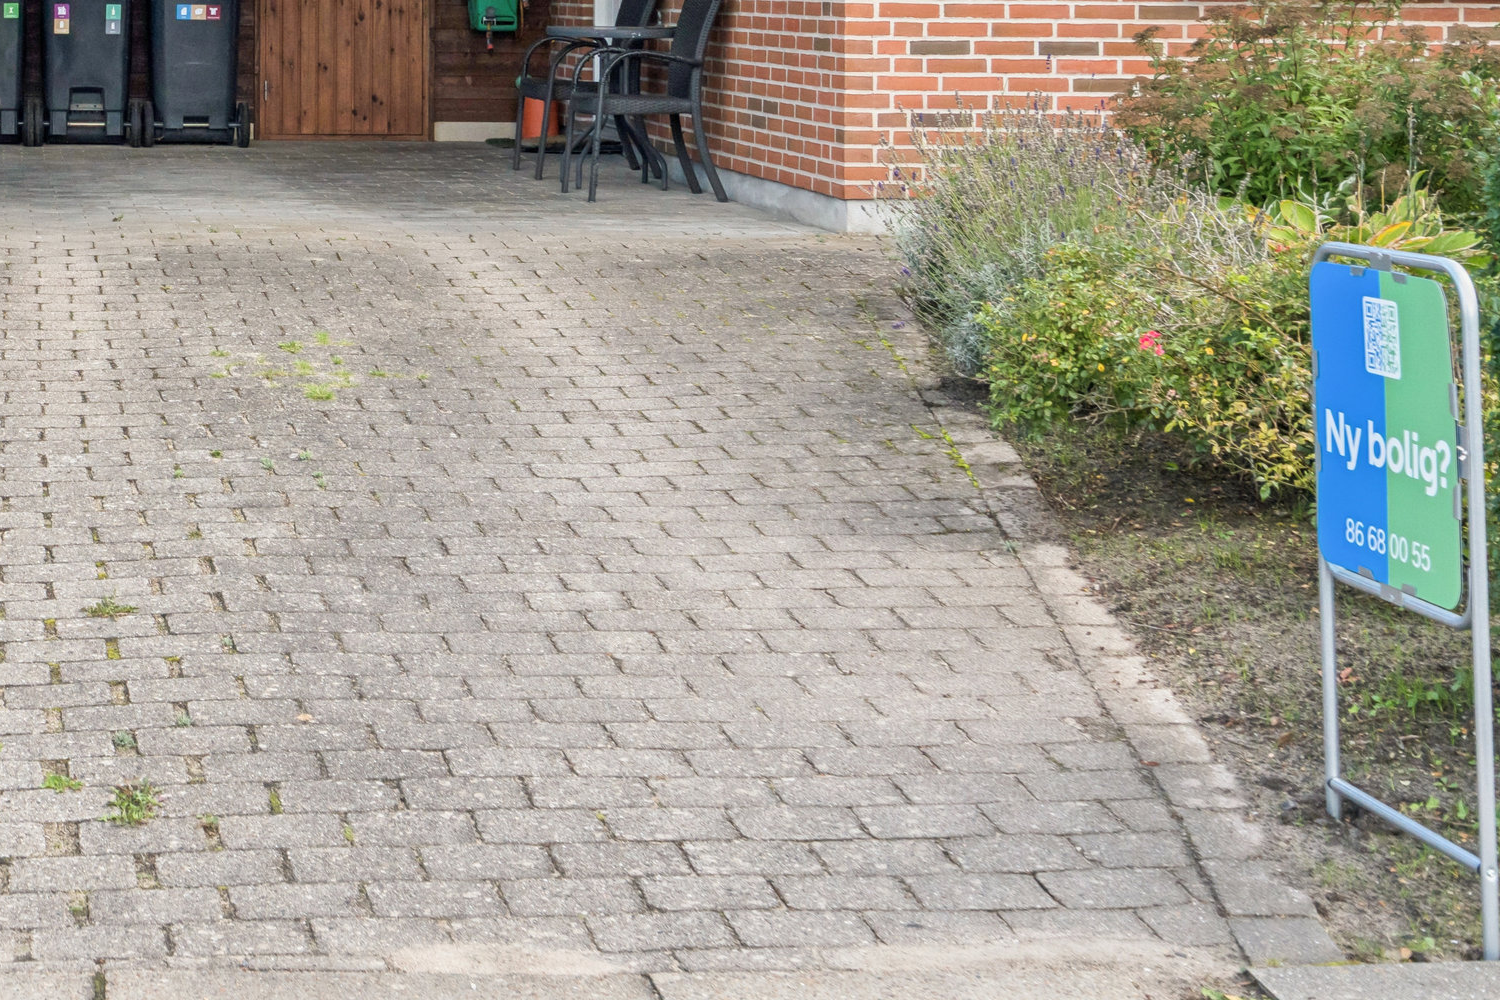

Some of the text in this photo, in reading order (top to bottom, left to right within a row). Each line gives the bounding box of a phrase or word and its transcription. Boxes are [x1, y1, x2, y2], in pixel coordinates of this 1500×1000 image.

[1325, 408, 1451, 497] Ny bolig?
[1345, 517, 1431, 572] 86 68 00 55
